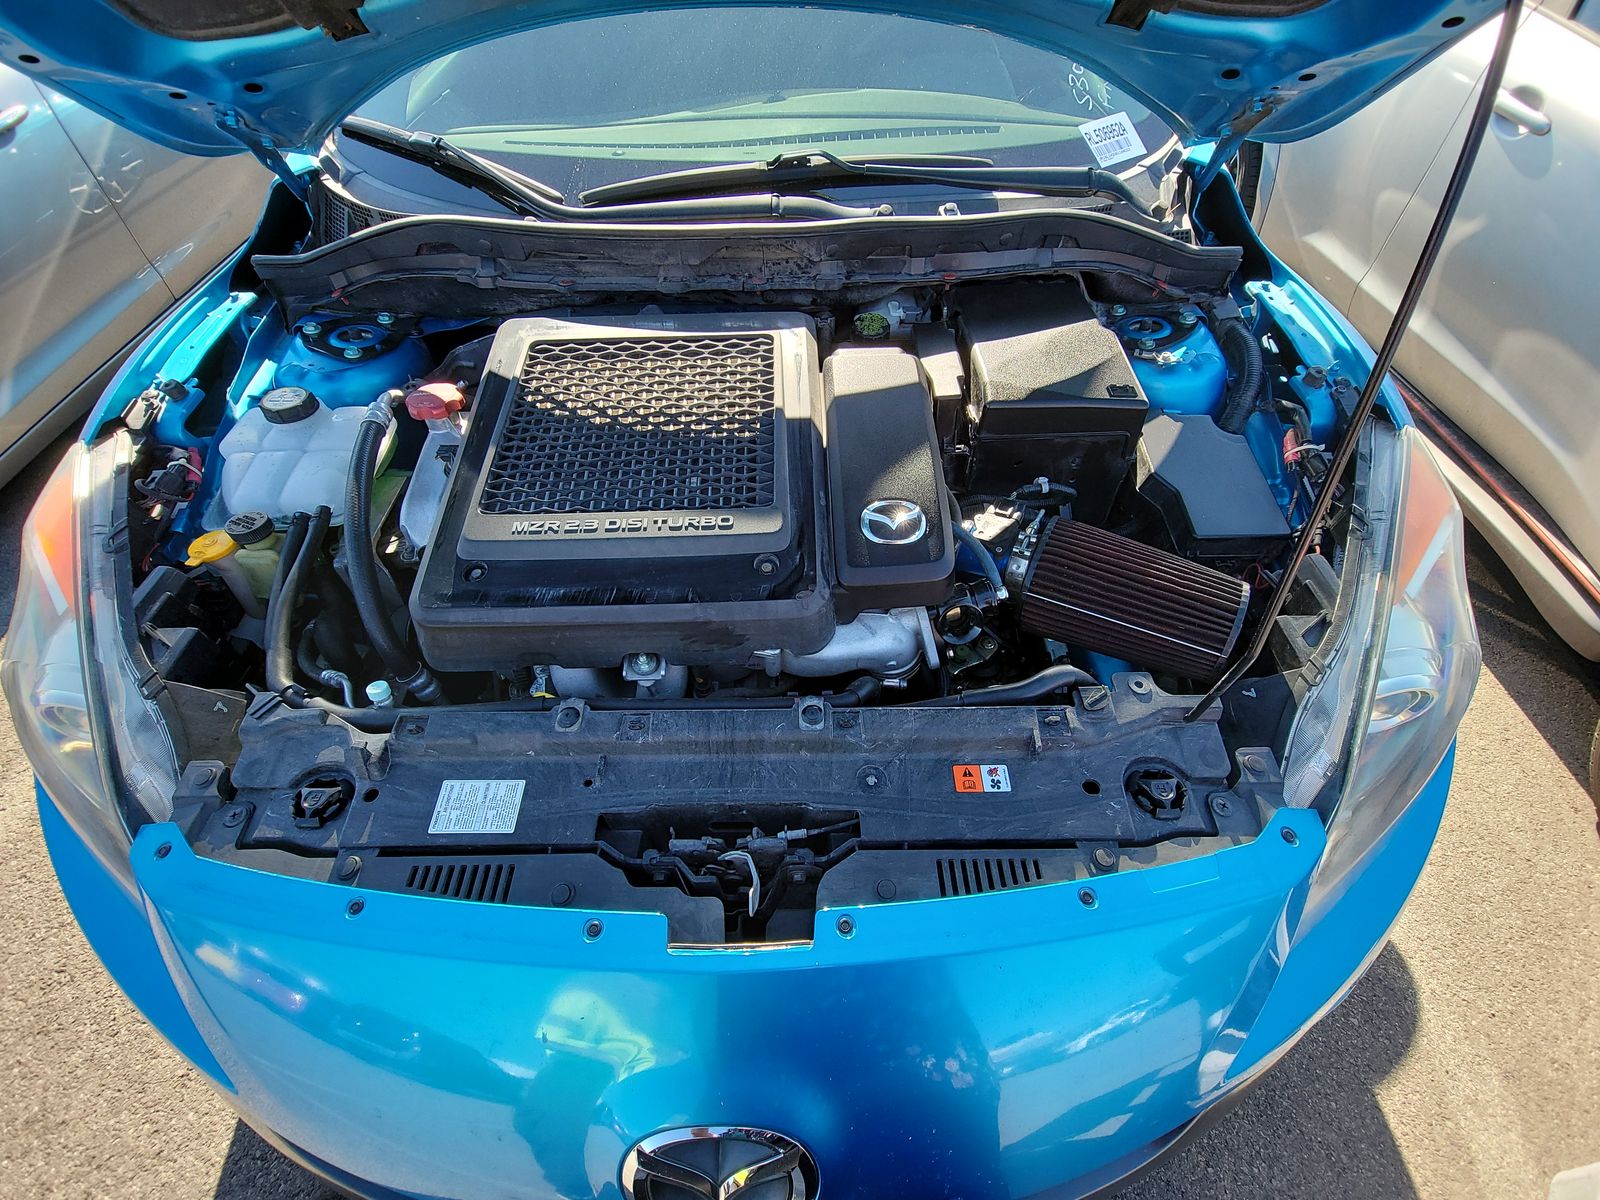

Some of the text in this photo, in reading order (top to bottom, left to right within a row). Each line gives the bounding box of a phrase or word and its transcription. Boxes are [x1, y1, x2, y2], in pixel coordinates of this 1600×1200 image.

[1084, 121, 1128, 146] RL506952A
[511, 515, 735, 535] MZR 2.3 DISI TURBO
